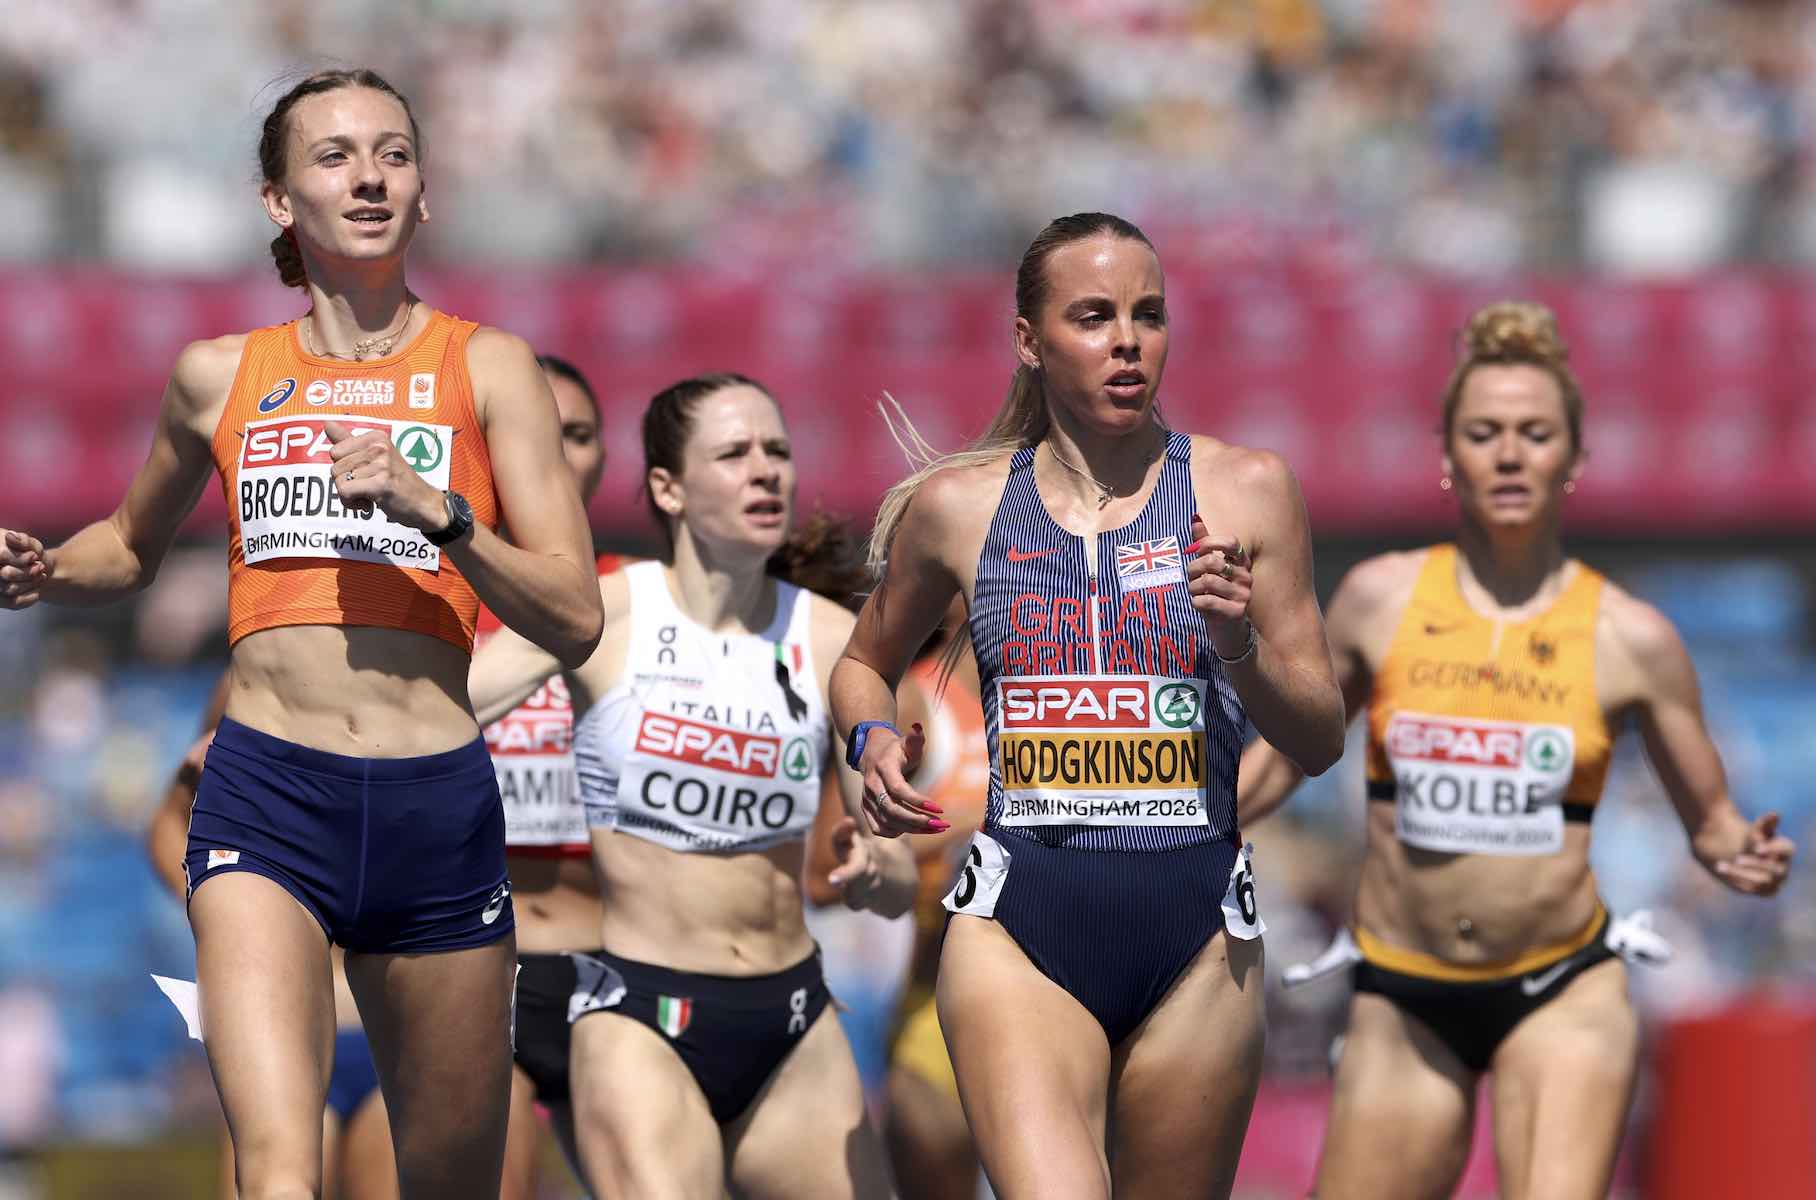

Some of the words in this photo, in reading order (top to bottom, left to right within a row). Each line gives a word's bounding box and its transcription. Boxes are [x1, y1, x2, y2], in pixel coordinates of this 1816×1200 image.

[333, 379, 395, 393] STAATS
[333, 392, 394, 405] LOTERIJ
[247, 426, 375, 462] SPA
[247, 532, 373, 554] BIRMINGHAM
[380, 538, 428, 559] 2026
[1011, 585, 1175, 638] GREAT
[1003, 633, 1196, 675] BRITAIN
[671, 701, 776, 732] ITALIA
[1005, 687, 1146, 721] SPAR
[638, 716, 778, 773] SPAR
[1002, 739, 1200, 785] HODGKINSON
[1393, 722, 1519, 764] SPAR
[640, 771, 794, 828] COIRO
[1011, 799, 1139, 818] BIRMINGHAM
[1147, 799, 1197, 817] 2026
[1401, 769, 1546, 815] KOLBE
